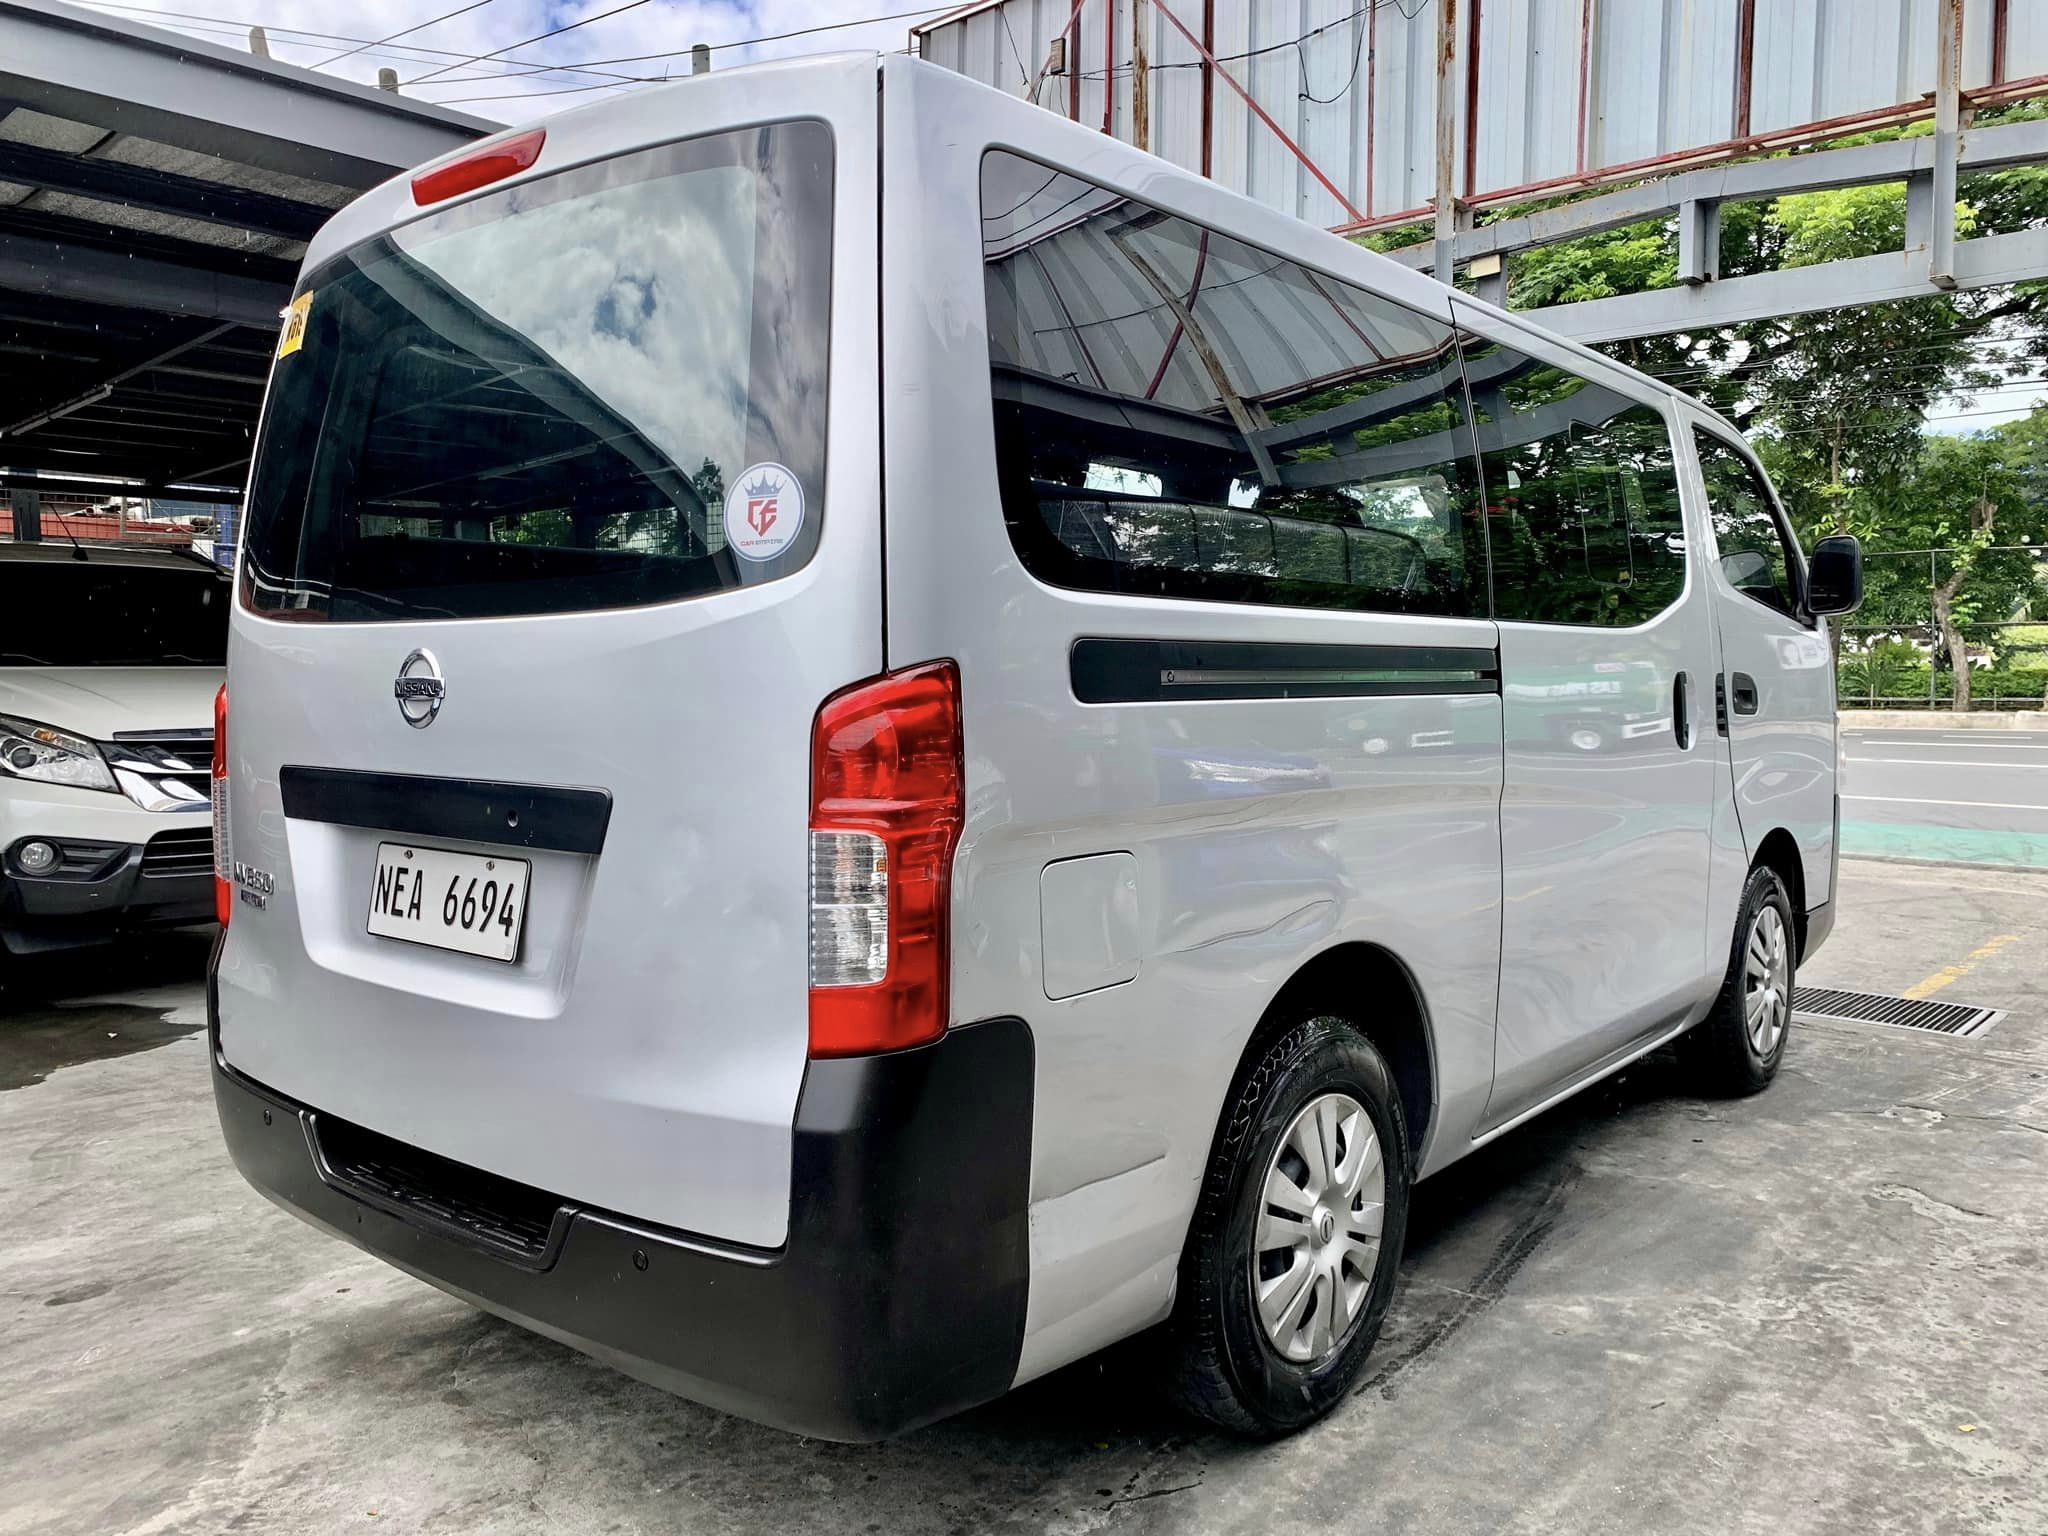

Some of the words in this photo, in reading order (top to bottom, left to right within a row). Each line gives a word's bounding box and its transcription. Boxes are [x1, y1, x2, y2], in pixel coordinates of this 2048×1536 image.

[395, 679, 436, 695] NISSAN
[374, 863, 423, 921] NEA
[442, 875, 514, 937] 6694
